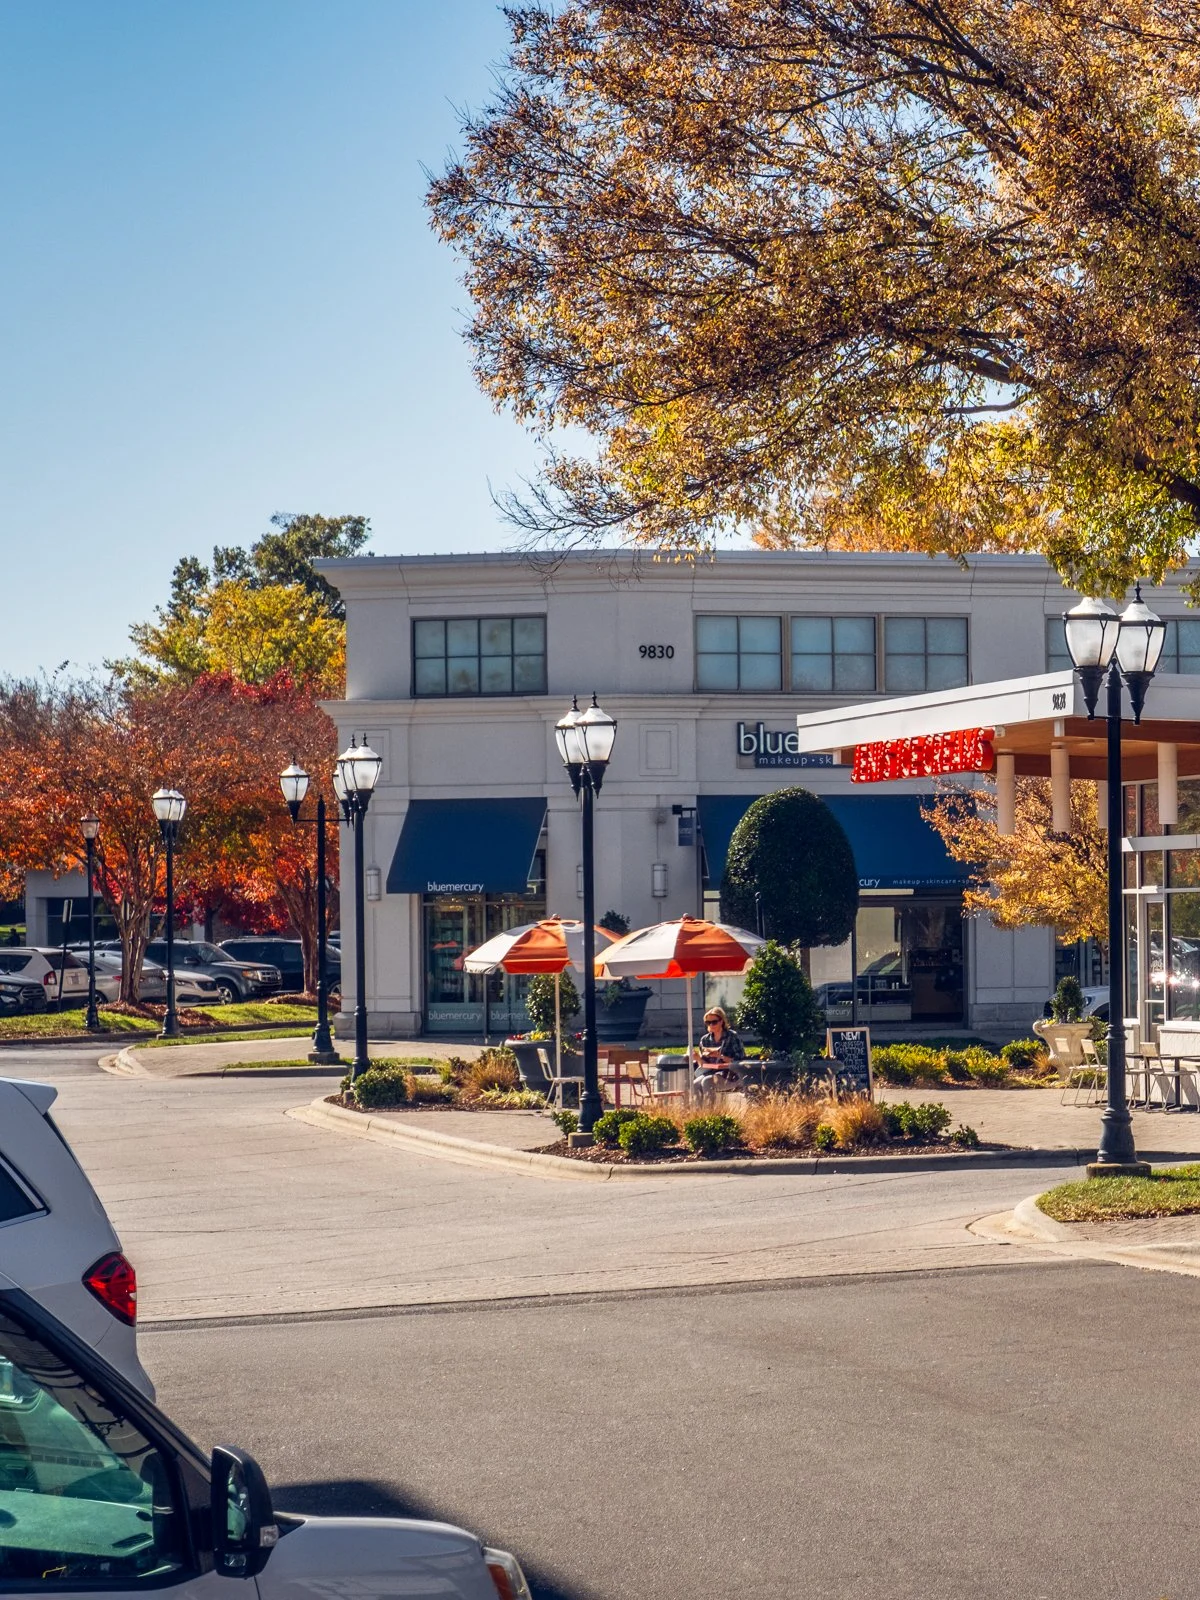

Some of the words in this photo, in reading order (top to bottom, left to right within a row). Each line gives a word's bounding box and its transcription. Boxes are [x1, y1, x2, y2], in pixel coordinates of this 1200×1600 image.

[639, 644, 675, 659] 9830
[740, 723, 799, 754] blue
[759, 754, 808, 766] makeup
[427, 881, 484, 893] bluemercury
[428, 1010, 481, 1020] bluemercury
